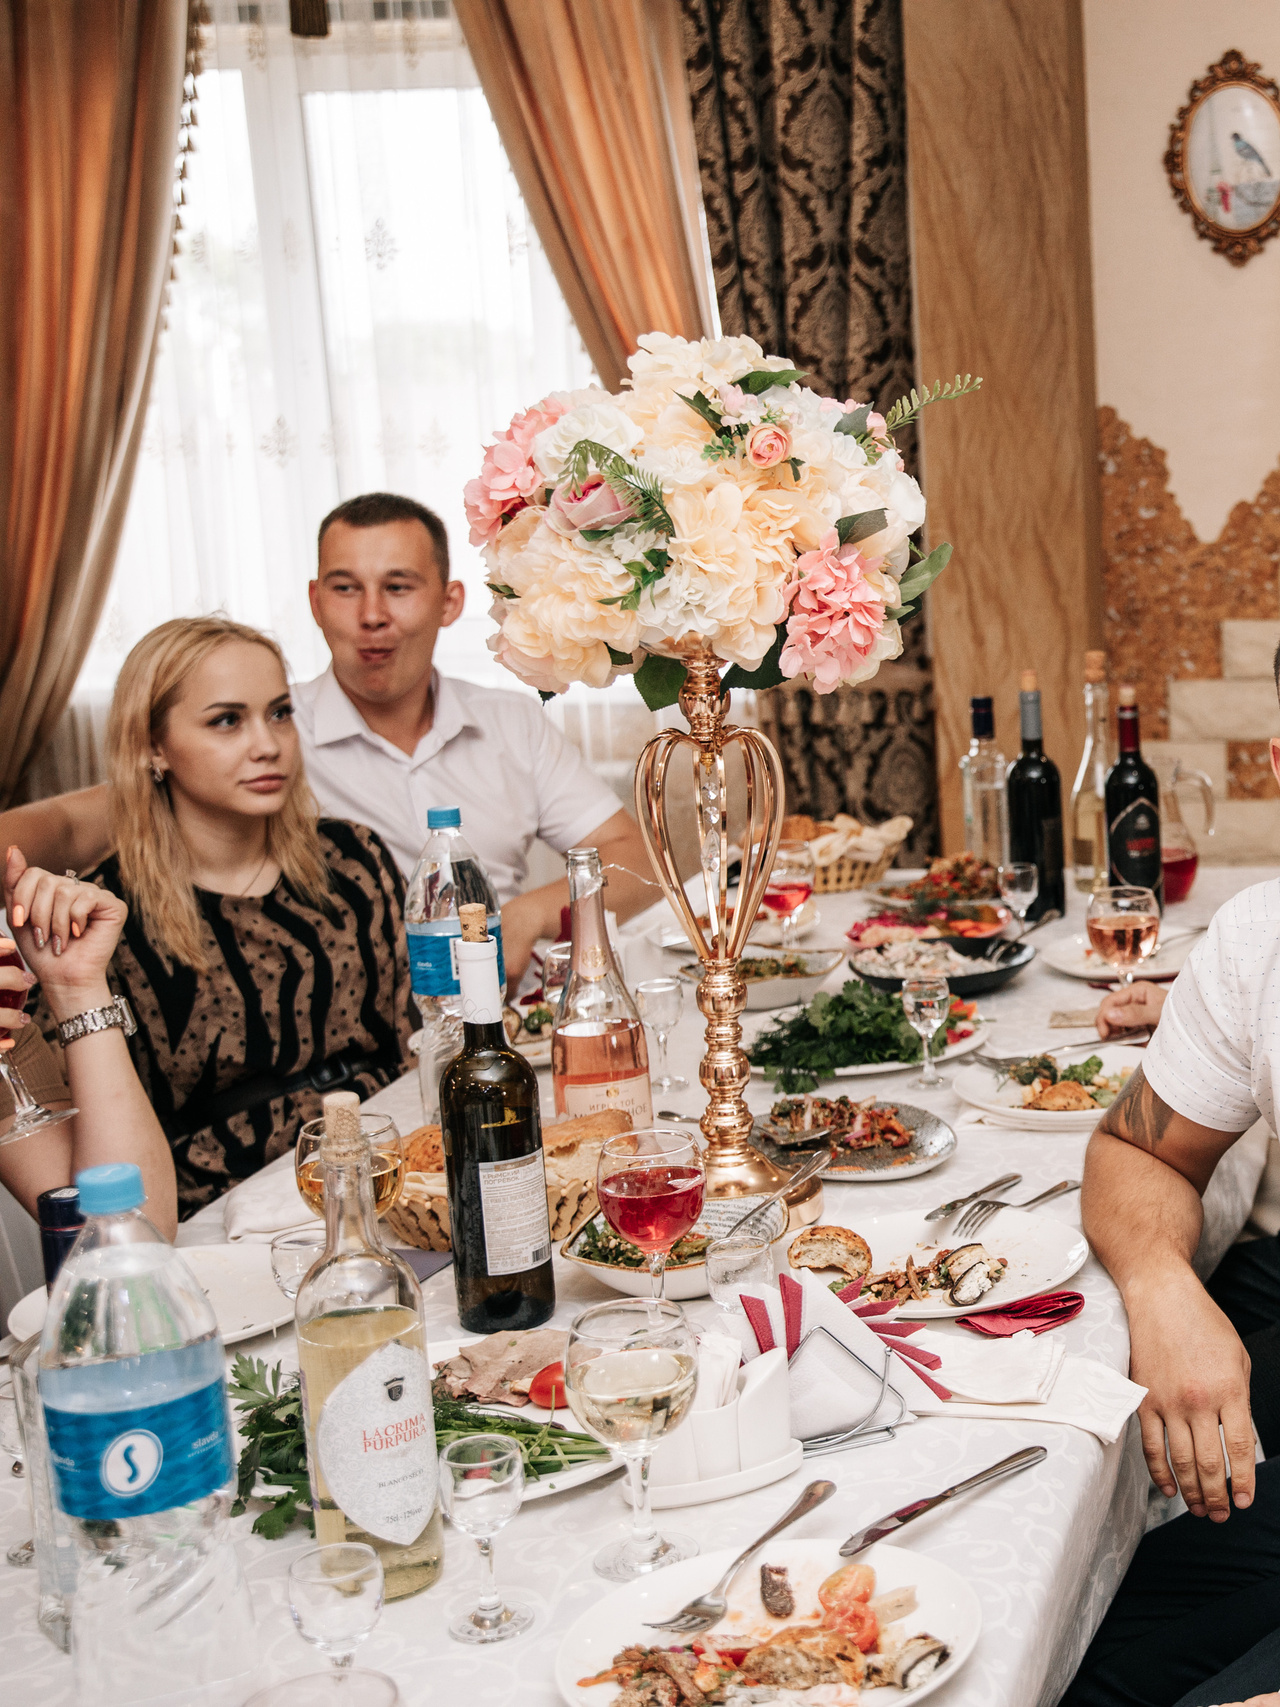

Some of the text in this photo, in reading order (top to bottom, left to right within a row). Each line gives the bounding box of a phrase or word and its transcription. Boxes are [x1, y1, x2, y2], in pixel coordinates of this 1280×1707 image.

[589, 1098, 635, 1111] ИГРСТОЕ
[484, 1176, 520, 1185] ПОГРЕБОК
[363, 1412, 426, 1441] LACRIMA
[363, 1424, 427, 1453] PURPURA
